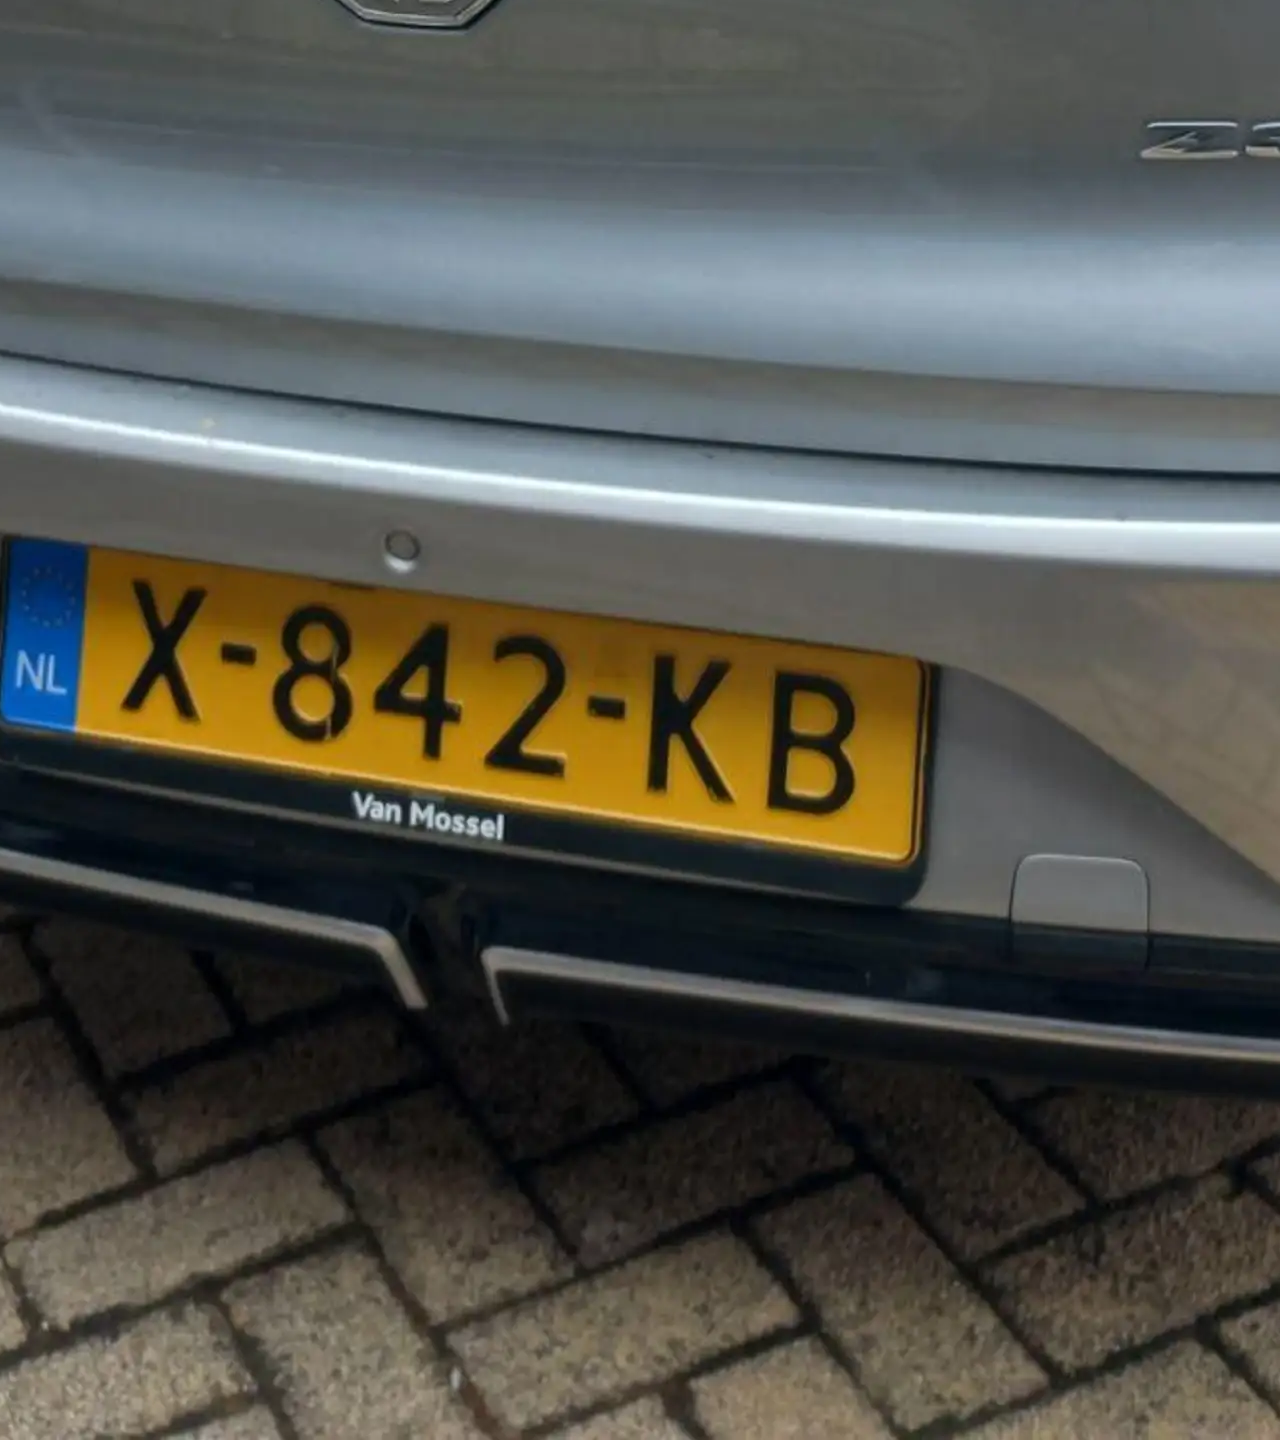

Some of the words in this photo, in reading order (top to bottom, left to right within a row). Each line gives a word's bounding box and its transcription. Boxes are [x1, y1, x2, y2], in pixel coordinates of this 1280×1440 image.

[15, 648, 68, 697] NL
[120, 578, 856, 816] X-842-KB
[351, 789, 402, 825] Van
[409, 800, 505, 841] Mossel
